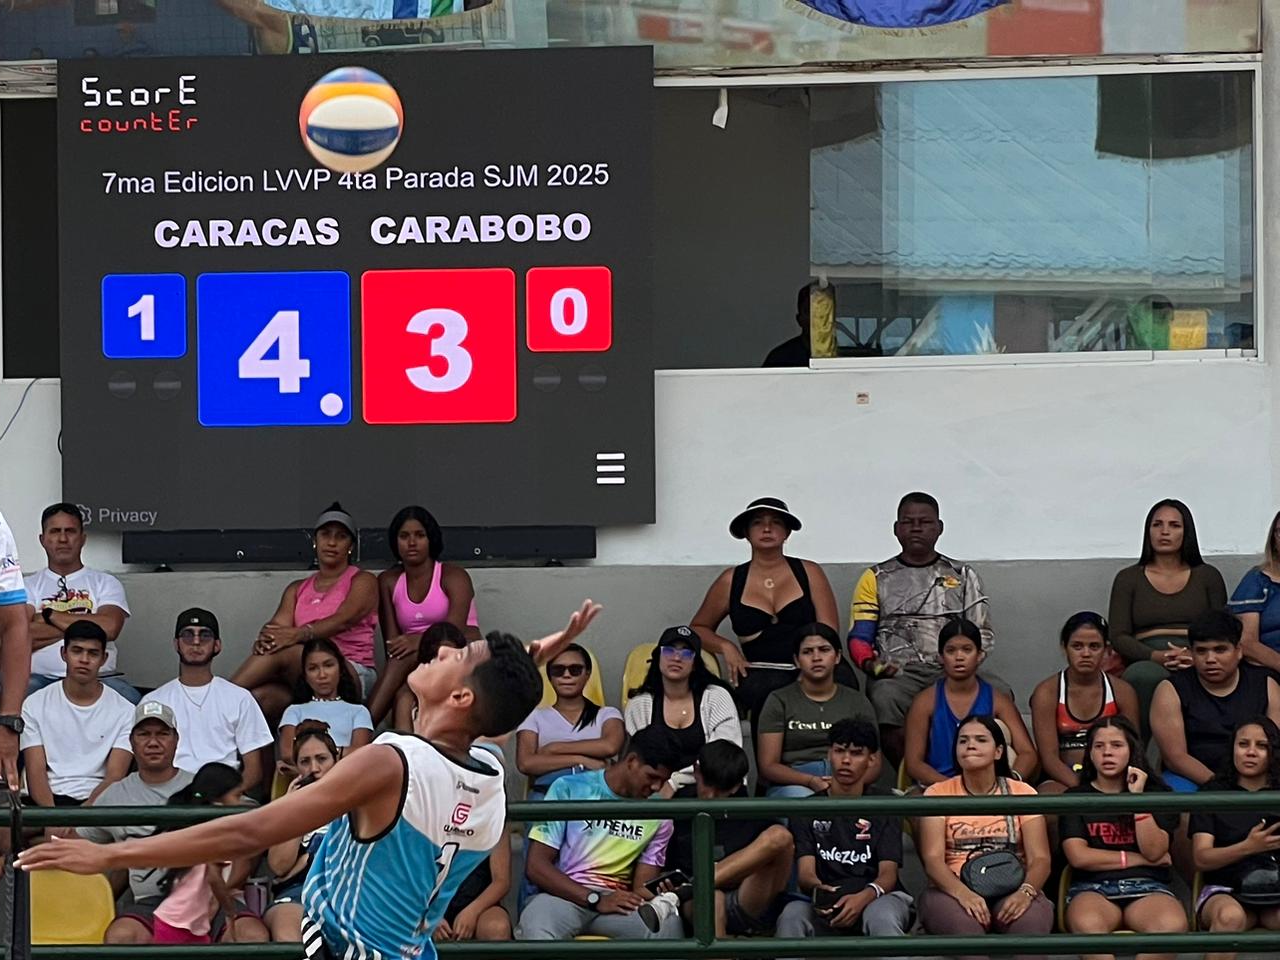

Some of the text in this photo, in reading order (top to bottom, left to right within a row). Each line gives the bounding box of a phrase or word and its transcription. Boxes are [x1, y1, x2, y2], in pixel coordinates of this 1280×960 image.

[102, 163, 609, 194] 7ma Edicion LVVP 4ta Parada SJM 2025
[154, 212, 591, 248] CARACAS CARABOBO
[127, 288, 588, 393] 1 4 3 0
[98, 507, 158, 526] Privacy
[583, 819, 644, 836] XTREME
